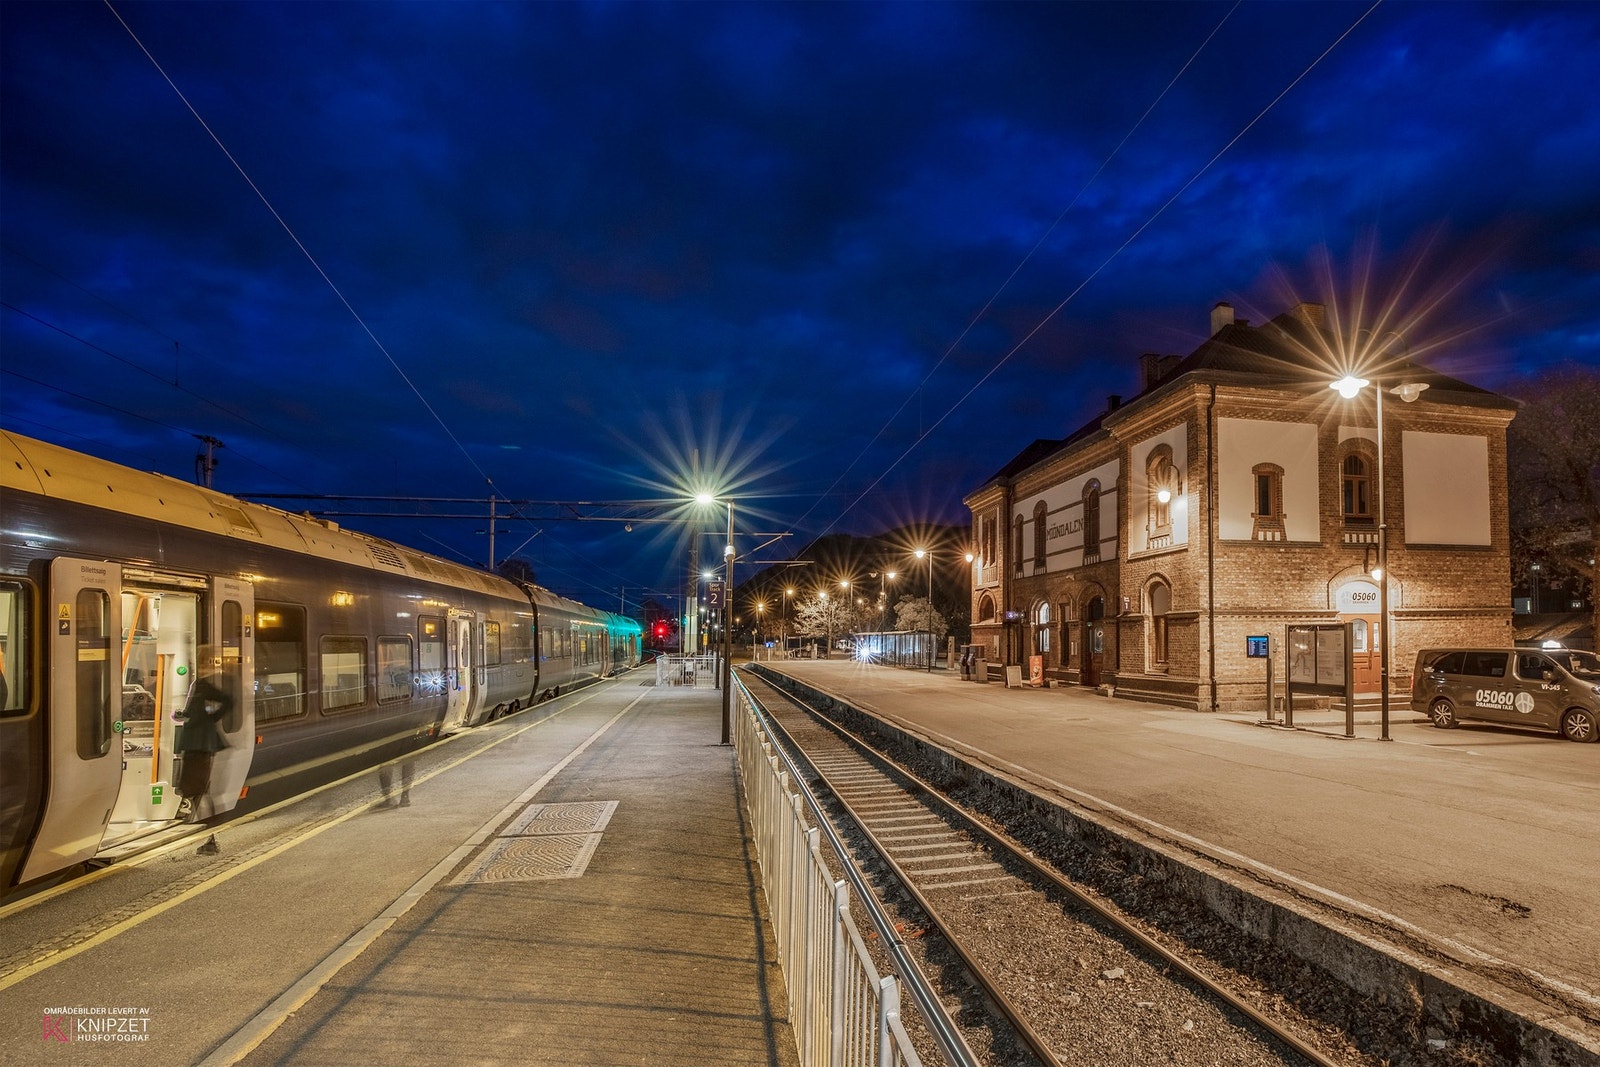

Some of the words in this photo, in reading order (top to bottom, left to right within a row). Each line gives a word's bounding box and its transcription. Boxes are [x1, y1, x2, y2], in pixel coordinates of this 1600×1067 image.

[710, 593, 718, 604] 2
[1352, 592, 1377, 601] 05060
[1475, 689, 1515, 705] 05060
[1475, 701, 1502, 710] DRAMMEN
